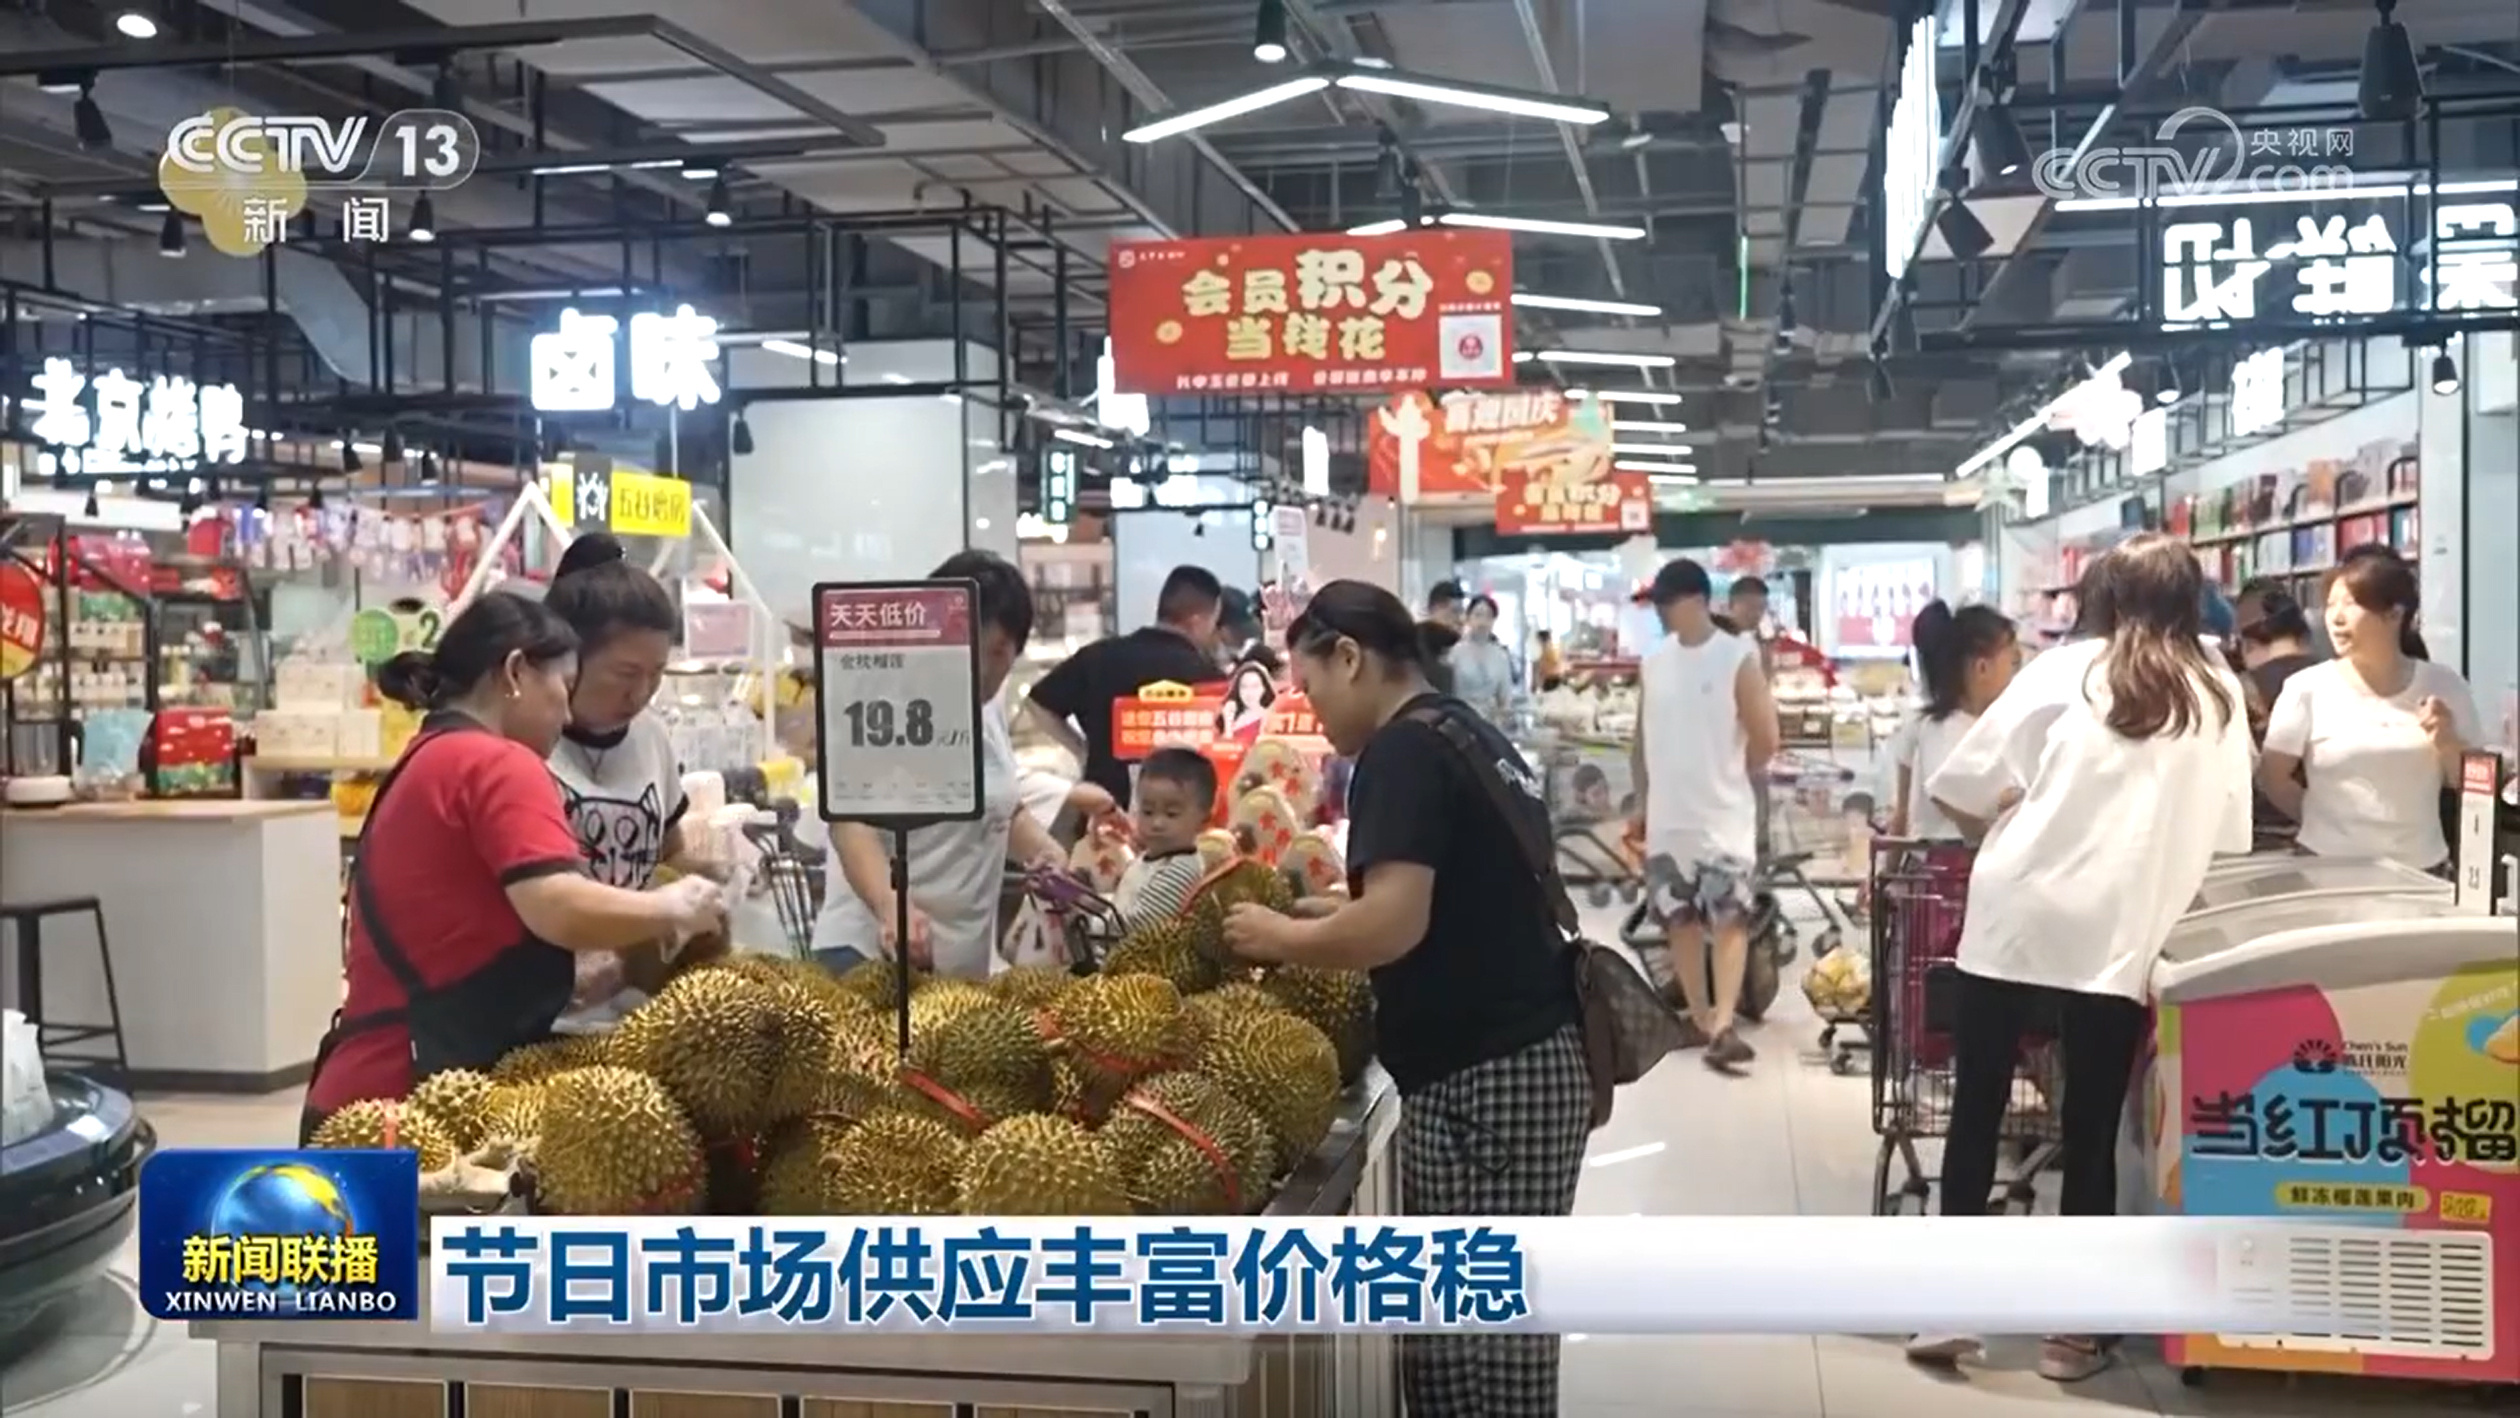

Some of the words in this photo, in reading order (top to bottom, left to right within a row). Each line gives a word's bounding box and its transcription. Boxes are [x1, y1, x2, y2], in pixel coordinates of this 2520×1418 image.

[1181, 249, 1434, 320] 会员积分
[531, 303, 722, 411] 卤味
[1226, 312, 1387, 362] 当钱花
[829, 601, 927, 628] 天天低价
[844, 698, 934, 747] 19.8
[2384, 1040, 2408, 1053] Sun
[2190, 1092, 2517, 1163] 当红顶榴
[2290, 1185, 2416, 1210] 鲜冻榴莲果肉
